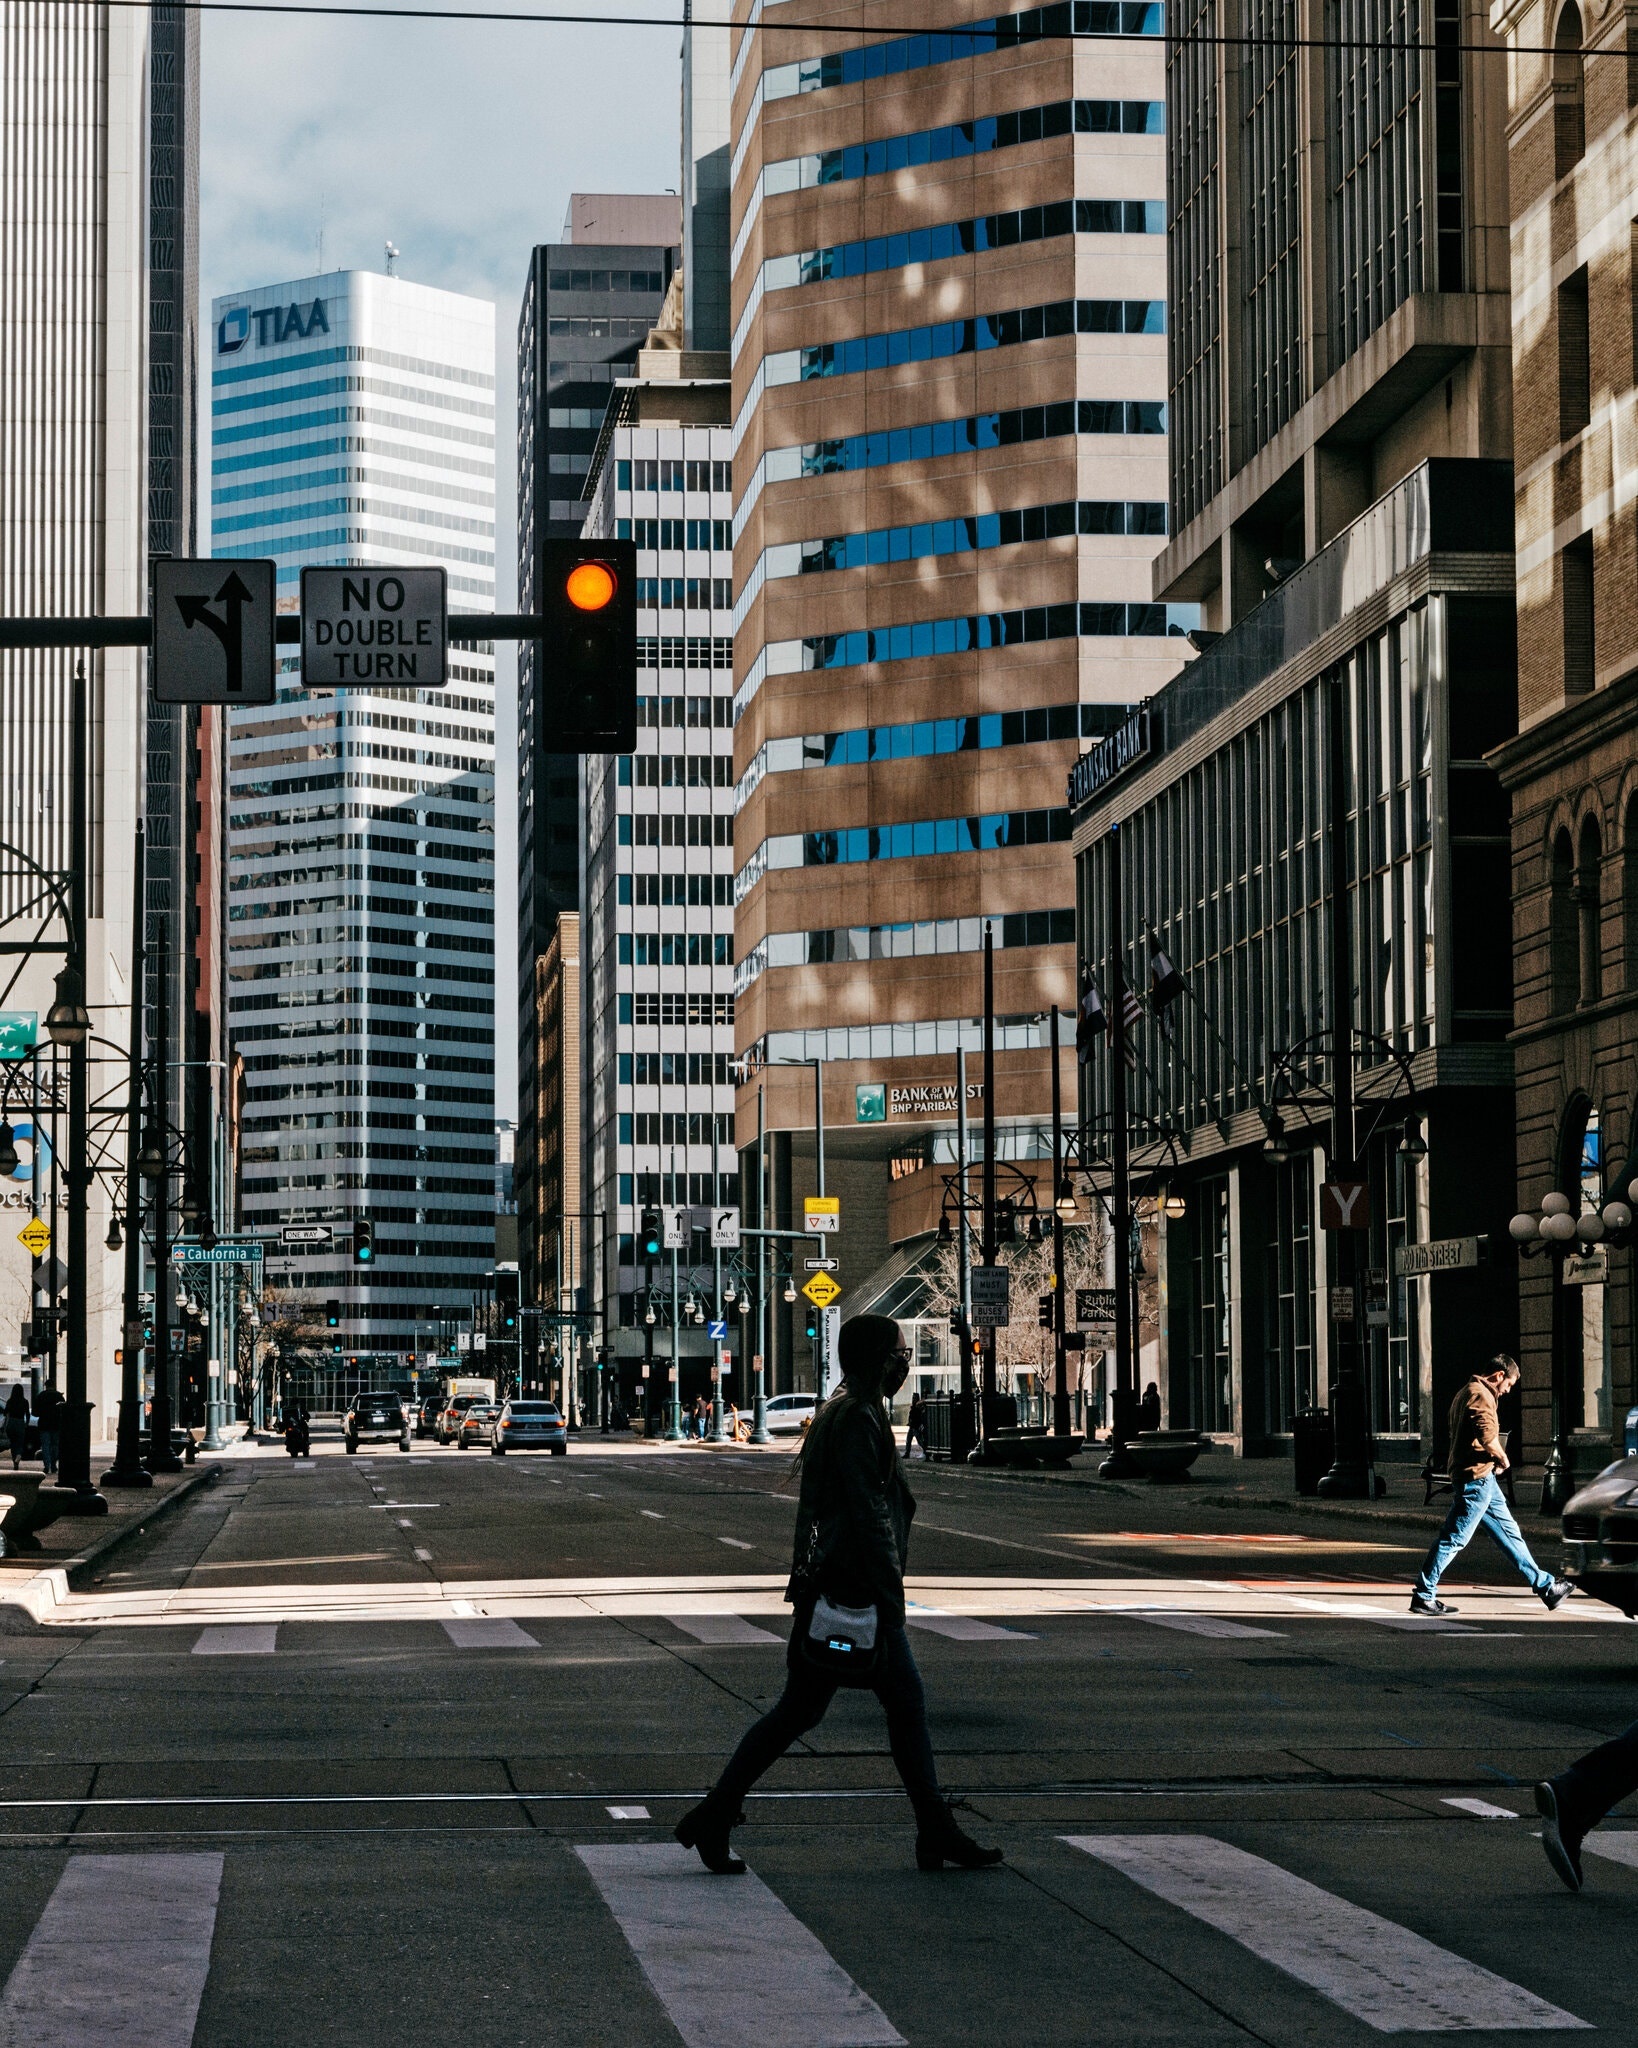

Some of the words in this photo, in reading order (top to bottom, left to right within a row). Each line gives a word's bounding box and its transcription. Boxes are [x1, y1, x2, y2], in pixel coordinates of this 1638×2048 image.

[251, 298, 330, 346] TIAA
[343, 577, 405, 613] NO
[316, 619, 433, 646] DOUBLE
[334, 653, 417, 678] TURN
[890, 1087, 930, 1102] BANK
[943, 1084, 985, 1100] WST
[891, 1103, 913, 1113] BNP
[914, 1101, 959, 1112] PARIBAS
[1329, 1185, 1363, 1226] Y
[668, 1232, 688, 1240] ONLY
[187, 1248, 247, 1260] California
[1429, 1241, 1461, 1267] STREET
[980, 1281, 1000, 1289] MUST
[1085, 1294, 1116, 1306] Public
[977, 1307, 1002, 1315] BUSES
[1081, 1306, 1116, 1318] Parkin
[974, 1316, 1006, 1324] EXCEPTED
[710, 1321, 725, 1338] Z
